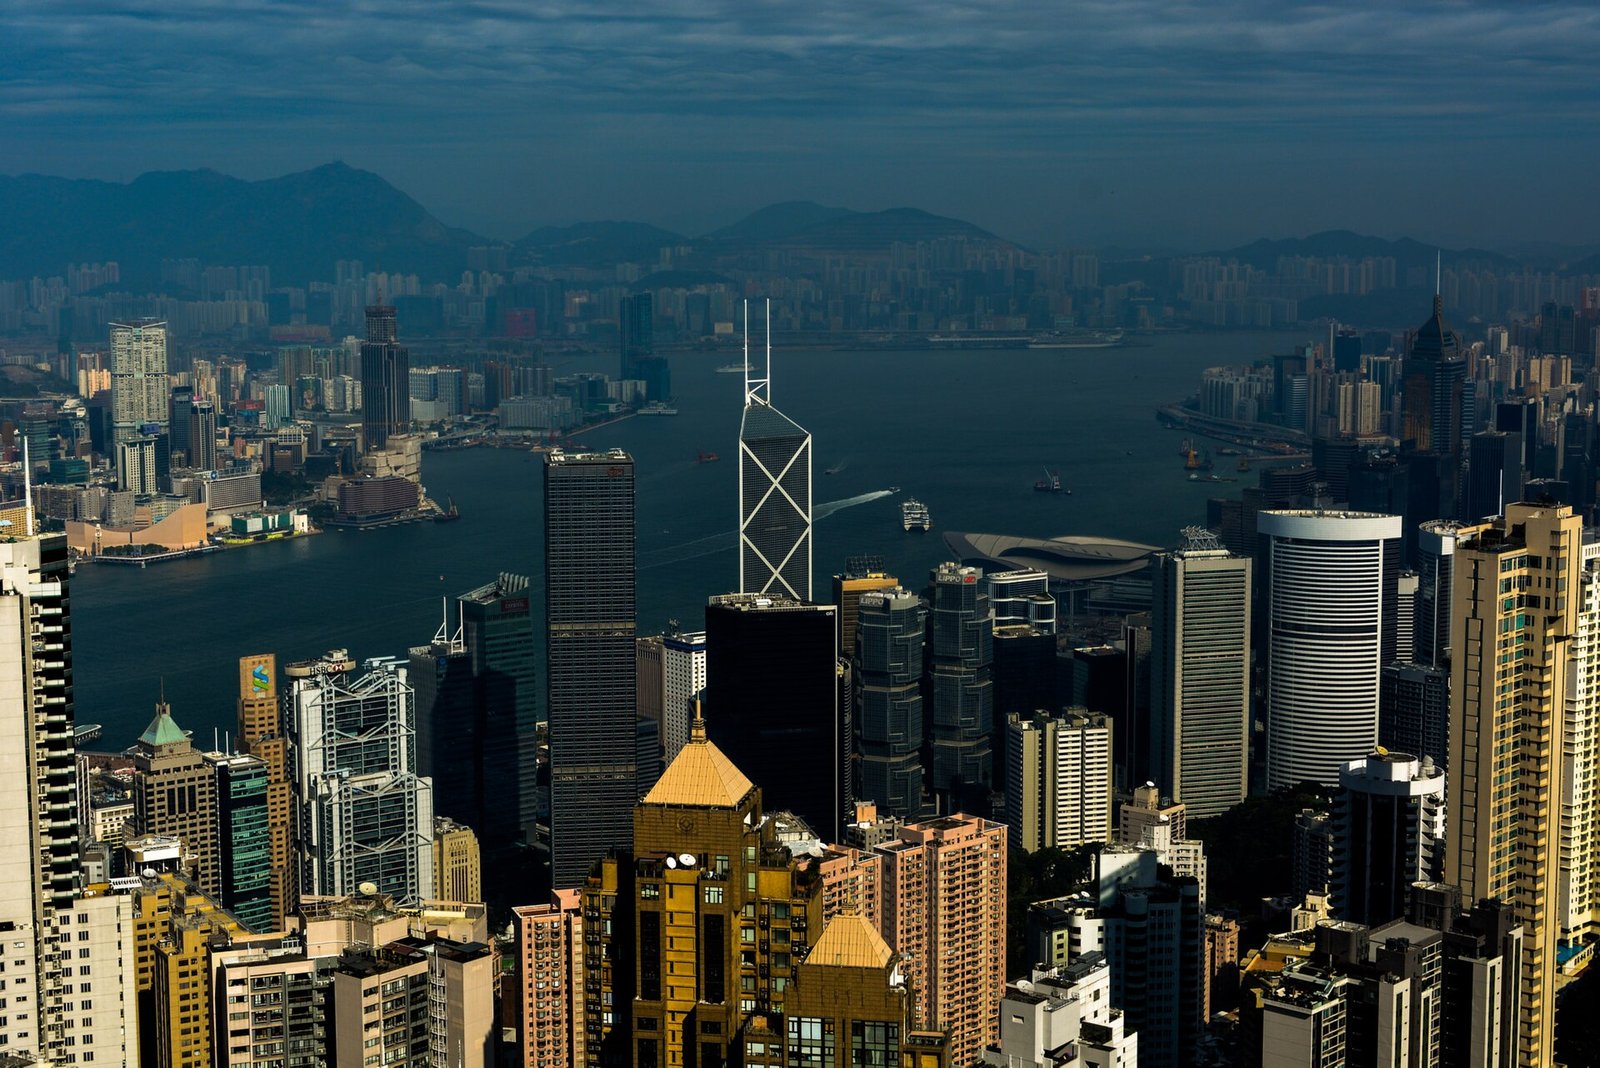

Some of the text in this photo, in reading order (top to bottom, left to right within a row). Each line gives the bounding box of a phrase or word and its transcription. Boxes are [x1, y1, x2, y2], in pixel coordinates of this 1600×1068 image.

[937, 574, 961, 583] LIPPO
[860, 597, 884, 606] LIPPO
[309, 664, 332, 677] HSBC
